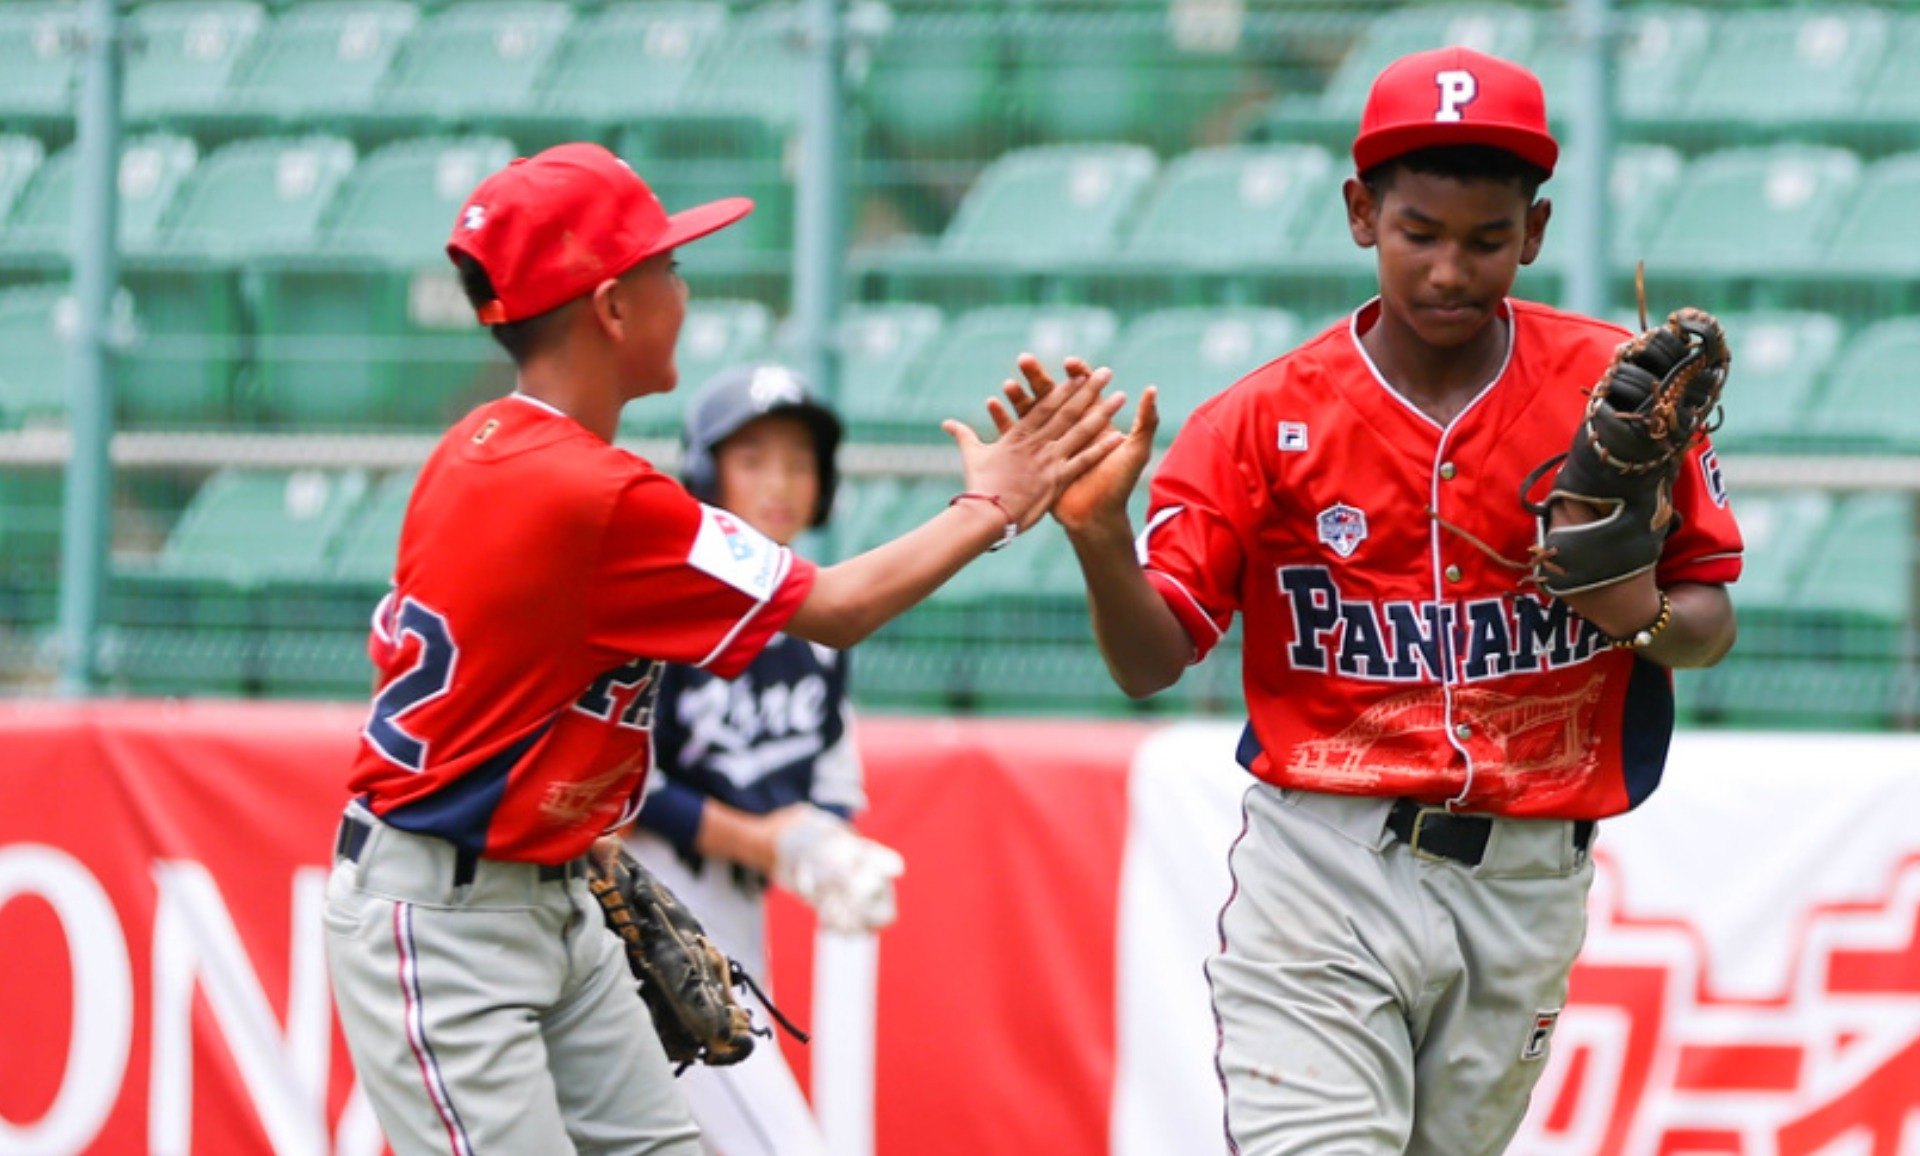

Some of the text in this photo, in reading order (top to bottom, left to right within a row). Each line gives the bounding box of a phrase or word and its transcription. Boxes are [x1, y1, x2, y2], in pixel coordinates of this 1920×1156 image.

[1434, 70, 1477, 122] P
[363, 595, 459, 774] 2
[0, 842, 388, 1156] ON
